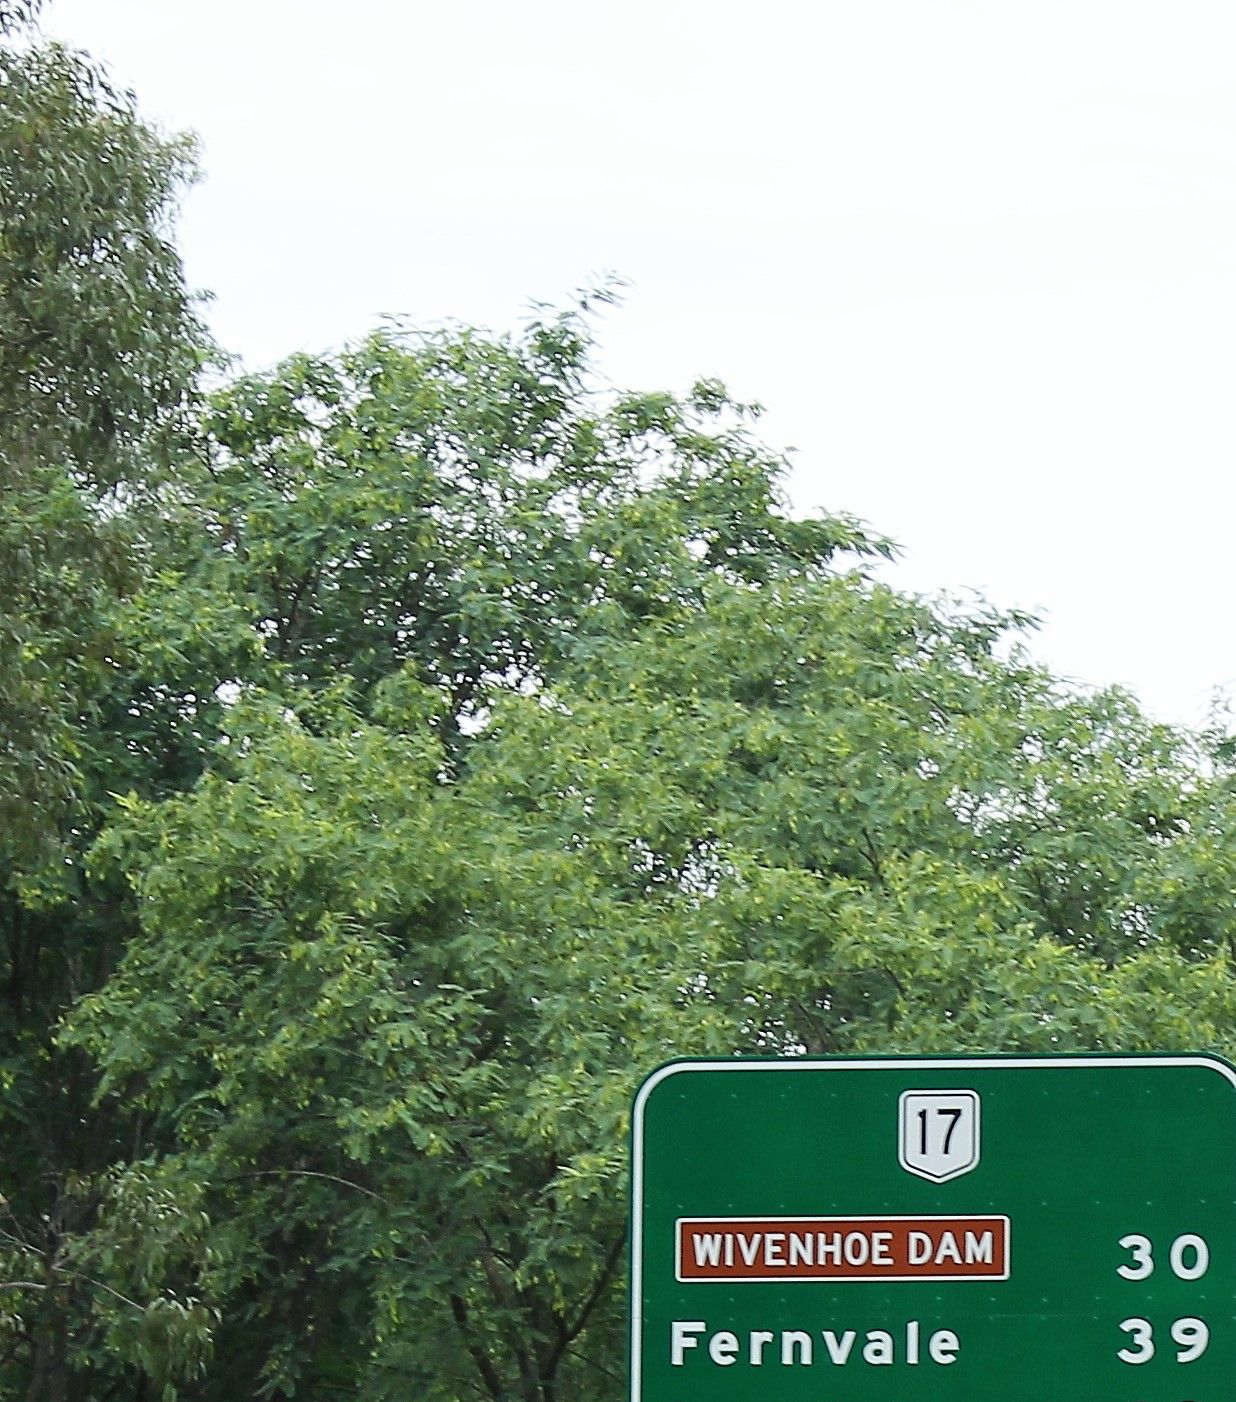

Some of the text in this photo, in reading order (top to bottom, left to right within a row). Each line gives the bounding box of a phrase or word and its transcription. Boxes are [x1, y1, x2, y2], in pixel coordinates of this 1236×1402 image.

[916, 1108, 962, 1156] 17
[692, 1230, 1210, 1281] WIVENHOE DAM 30
[670, 1316, 1210, 1366] Fernvale 39
